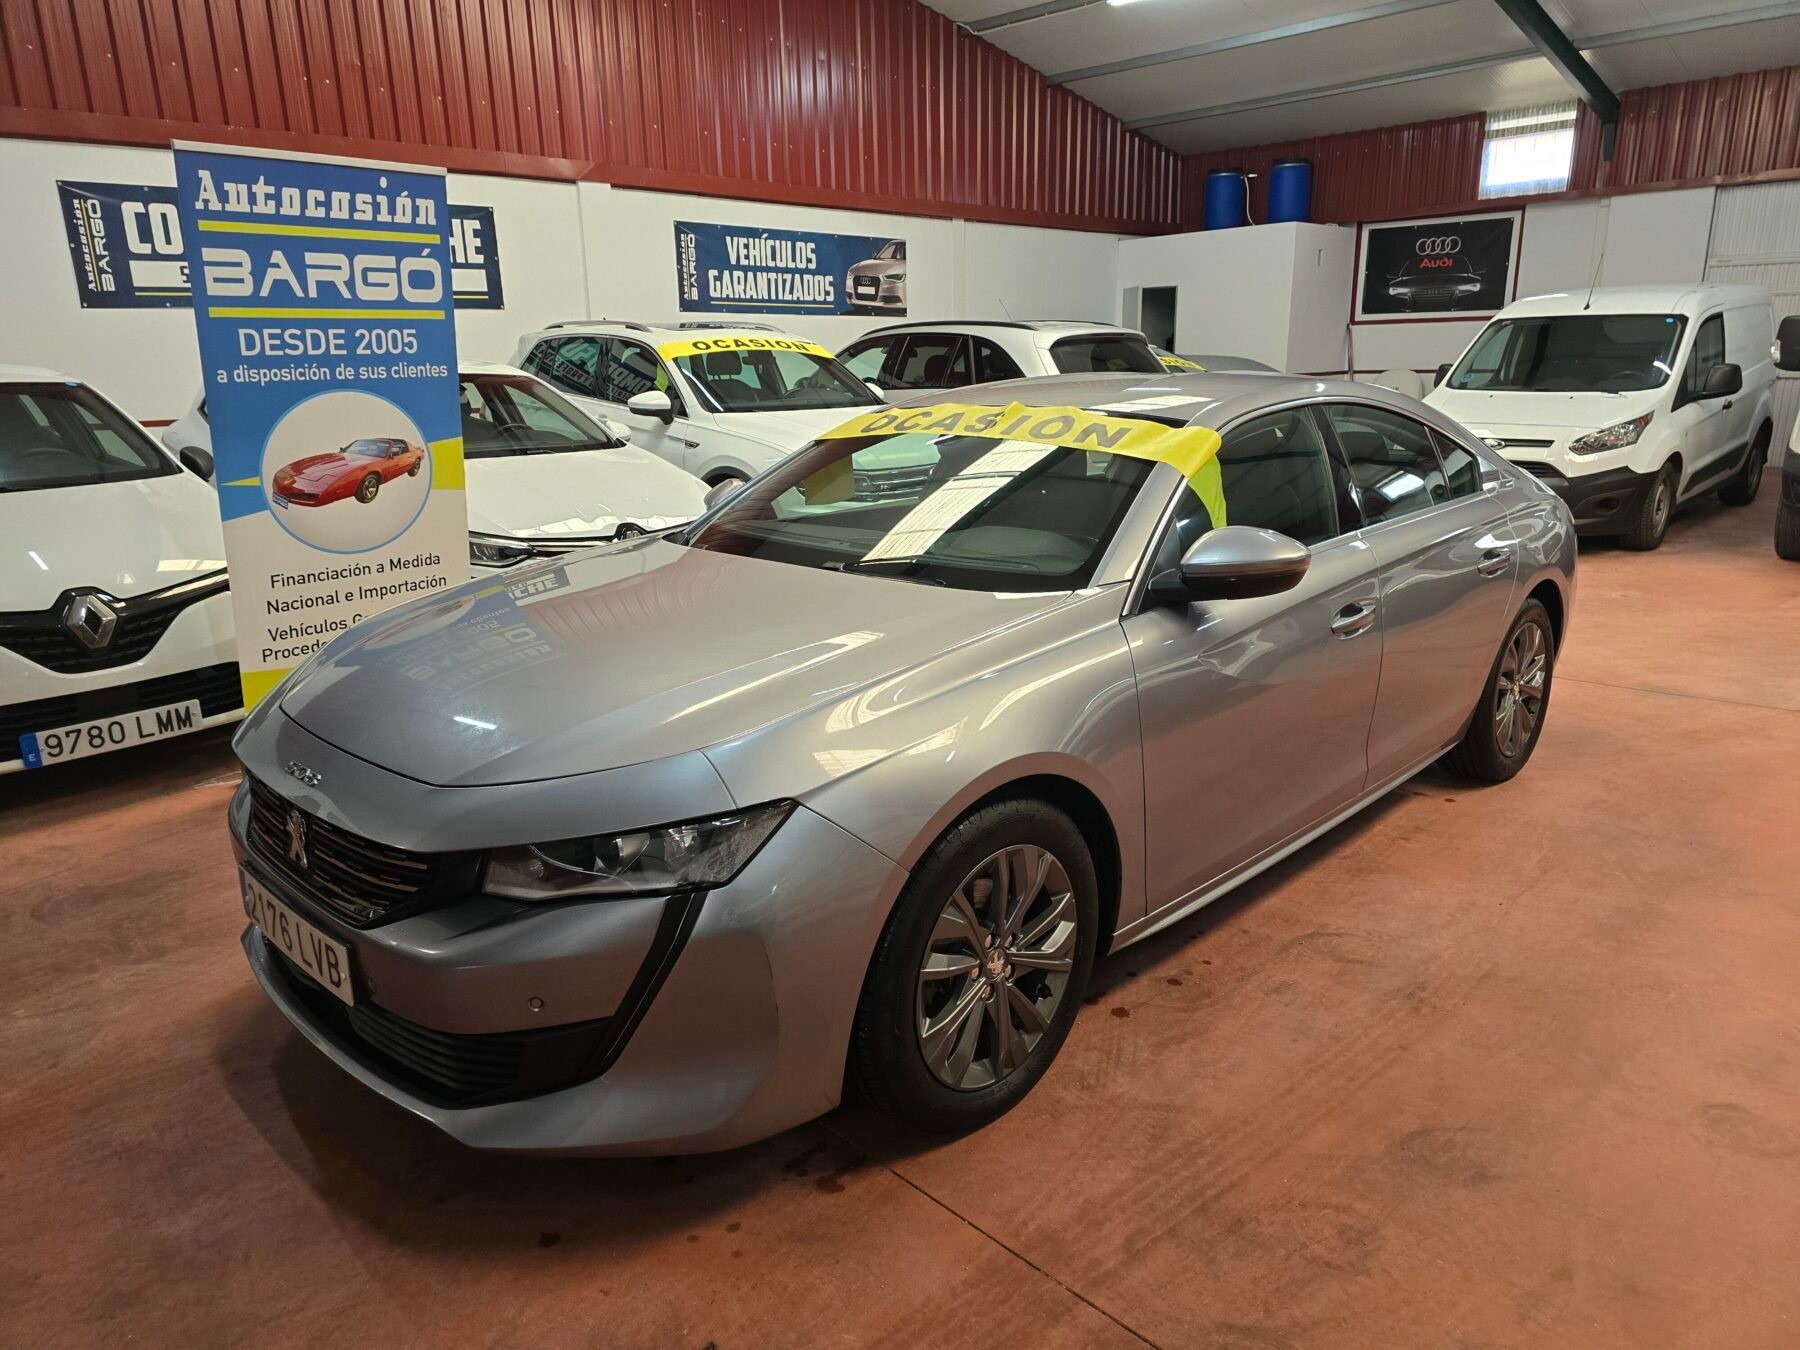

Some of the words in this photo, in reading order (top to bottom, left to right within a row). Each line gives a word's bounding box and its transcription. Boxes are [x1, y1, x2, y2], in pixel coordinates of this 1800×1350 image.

[195, 169, 437, 226] Autocasión
[725, 233, 817, 269] VEHÍCULOS
[1419, 257, 1453, 269] Audi
[201, 247, 443, 304] BARGÓ
[708, 269, 835, 302] GARANTIZADOS
[238, 328, 348, 357] DESDE
[354, 328, 418, 355] 2005
[691, 338, 811, 352] OCASION
[216, 369, 228, 384] a
[233, 362, 330, 387] disposición
[335, 363, 355, 380] de
[359, 365, 387, 380] sus
[391, 361, 449, 379] clientes
[860, 411, 1133, 449] OCASION
[270, 562, 372, 589] Financiación
[376, 563, 385, 574] a
[389, 552, 441, 572] Medida
[266, 589, 341, 615] Nacional
[344, 591, 354, 602] e
[358, 574, 447, 600] Importación
[267, 618, 348, 642] Vehículos
[262, 638, 328, 664] Proced
[44, 720, 126, 758] 9780
[135, 705, 193, 739] LMM
[248, 883, 293, 952] 2176
[296, 921, 342, 989] LVB
